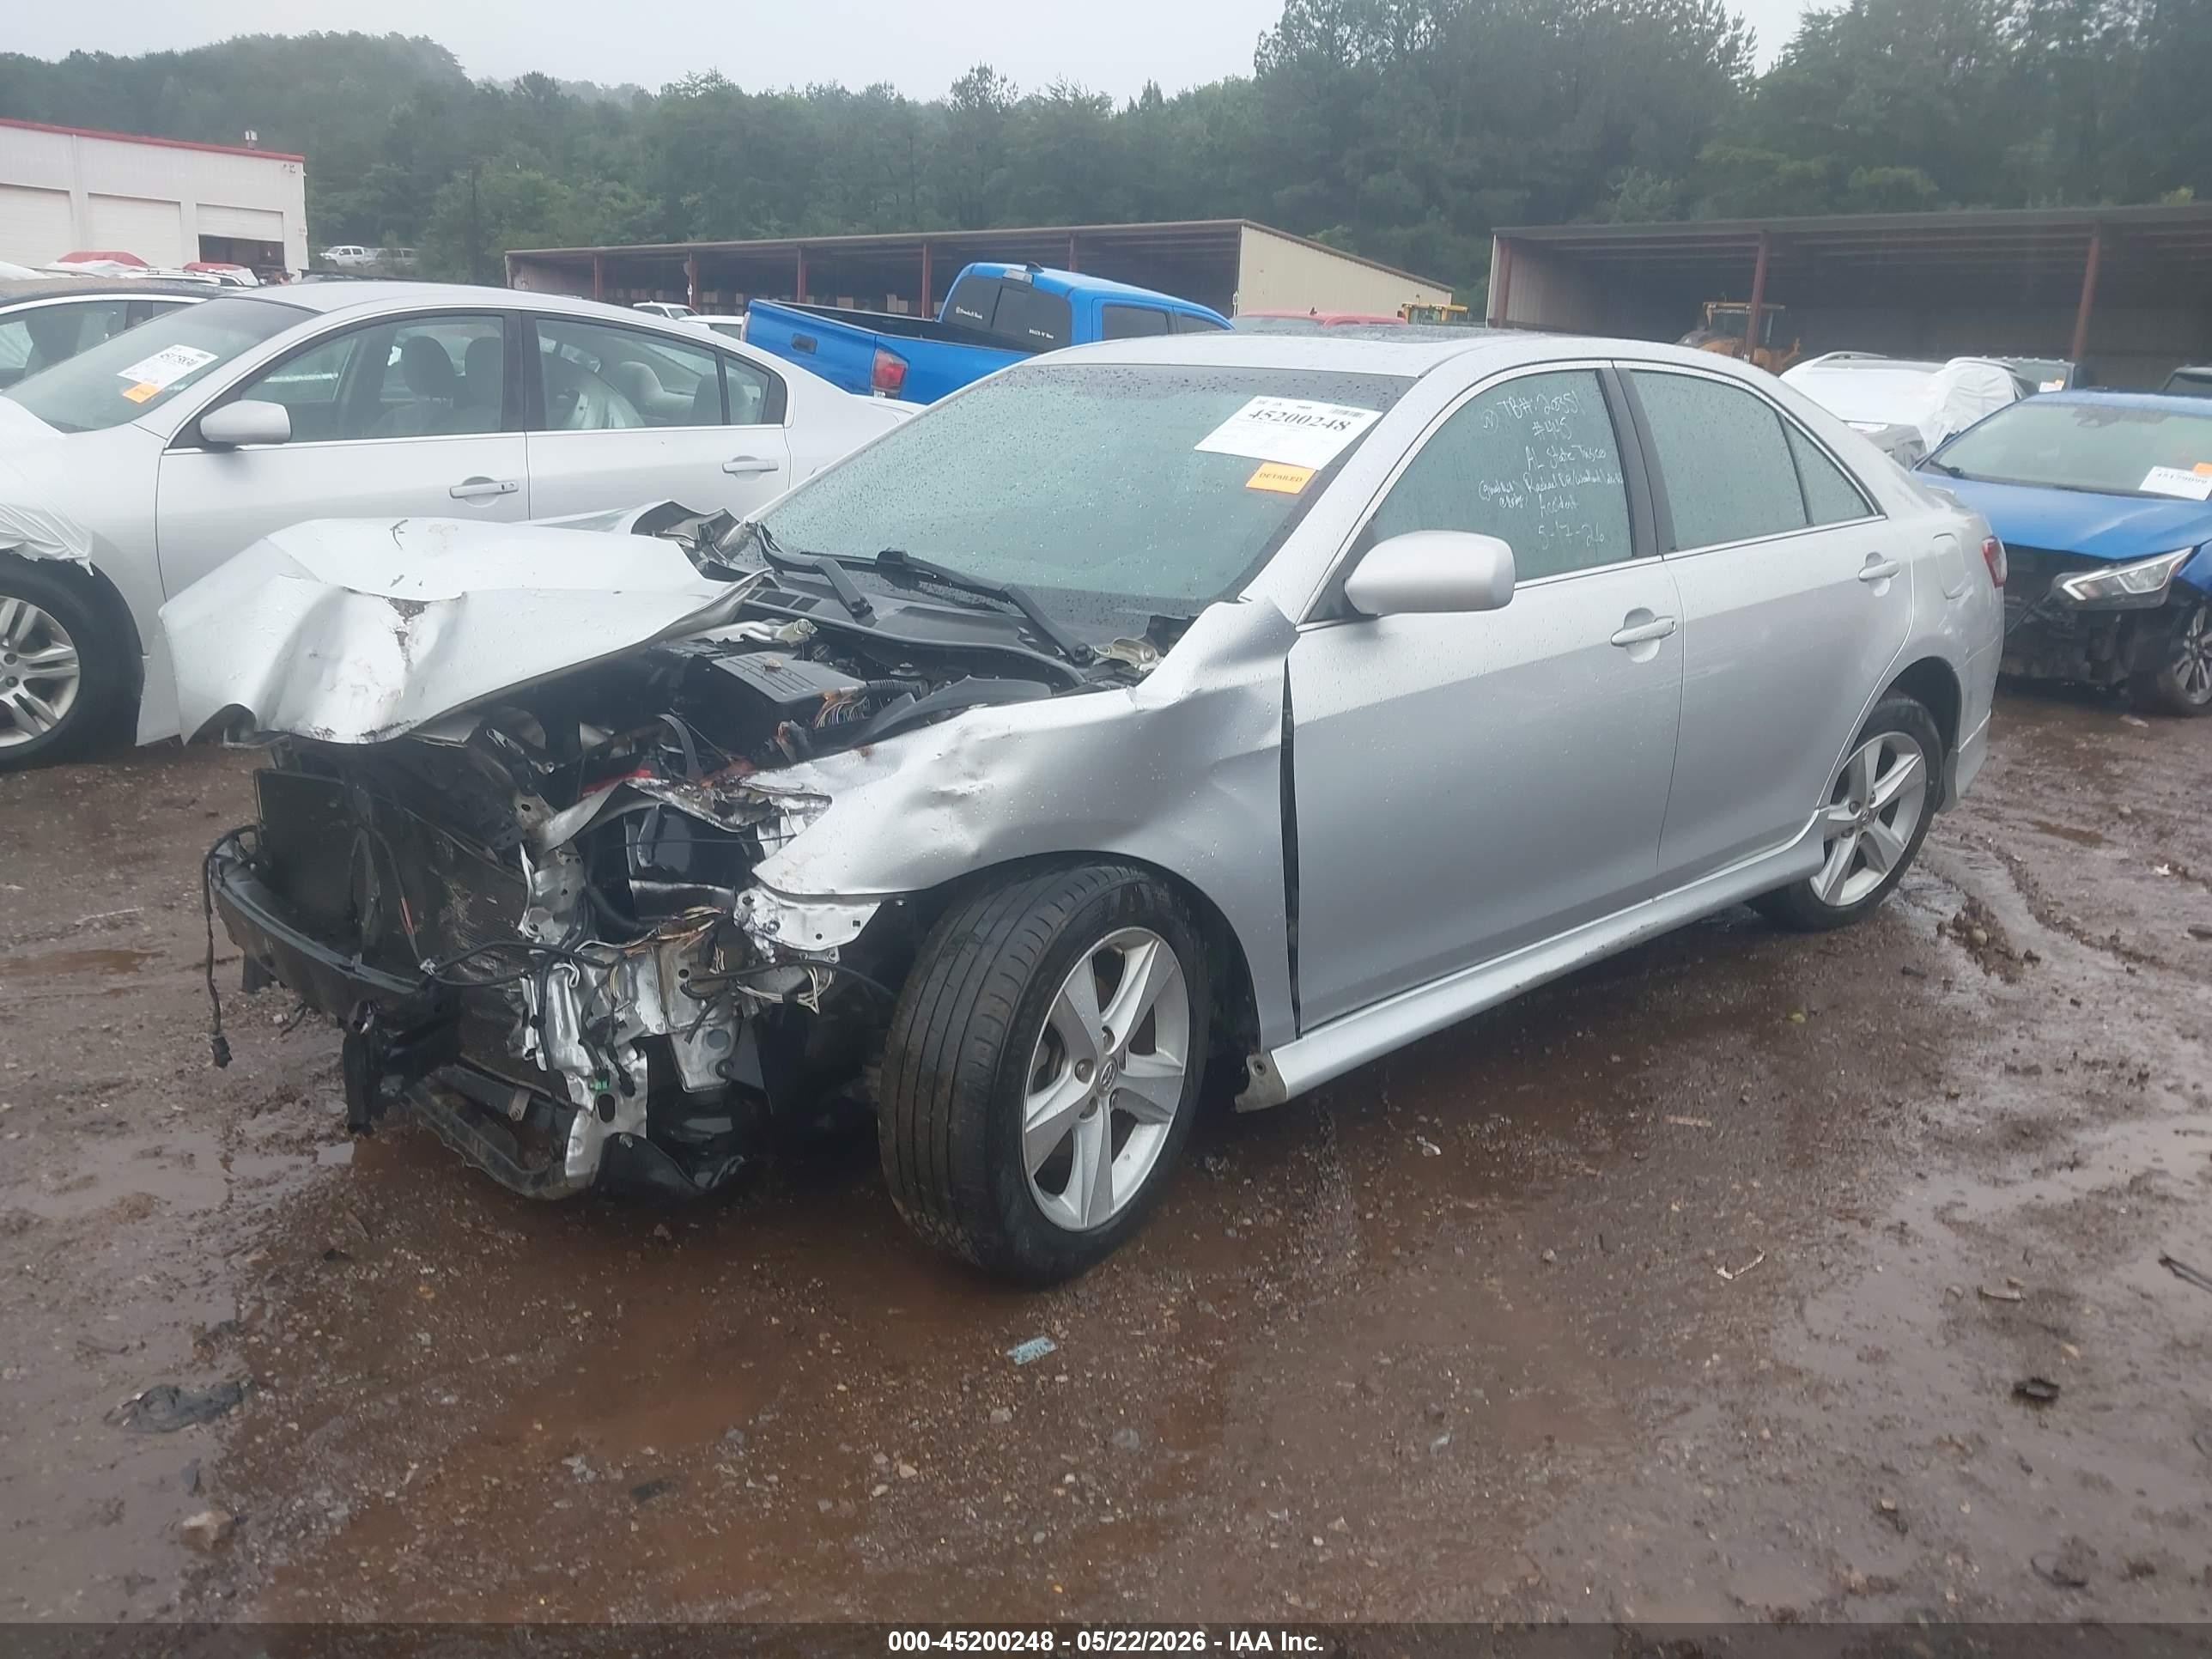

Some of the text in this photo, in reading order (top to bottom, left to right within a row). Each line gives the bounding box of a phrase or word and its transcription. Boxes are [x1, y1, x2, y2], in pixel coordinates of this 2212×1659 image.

[1249, 409, 1351, 431] 45200248
[1525, 446, 1545, 471] AL
[1546, 447, 1575, 469] State
[1258, 471, 1303, 483] DETAILED
